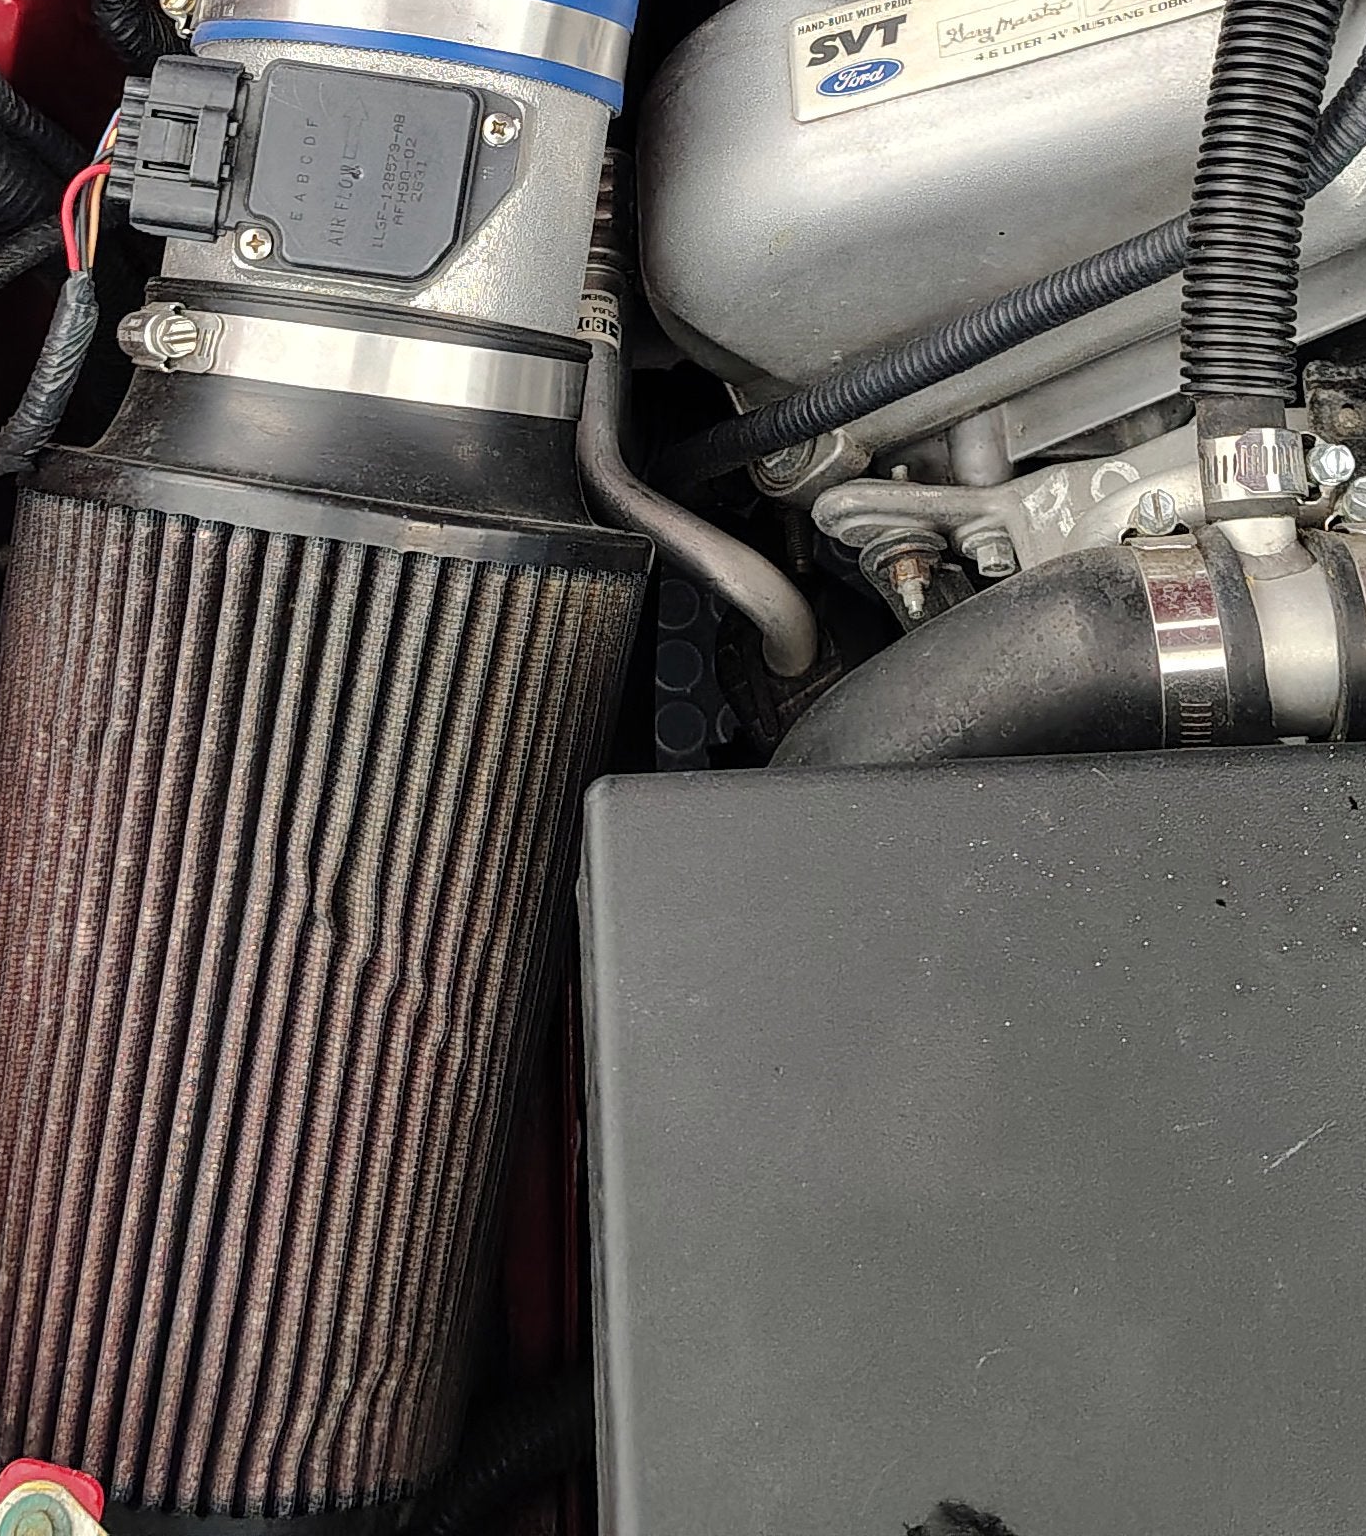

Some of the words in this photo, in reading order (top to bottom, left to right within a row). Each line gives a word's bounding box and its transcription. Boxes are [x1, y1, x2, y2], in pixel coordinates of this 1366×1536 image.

[797, 13, 853, 35] HAND-BUILT
[856, 4, 882, 18] WITH
[806, 14, 907, 68] SVT
[1003, 37, 1042, 54] LITER
[1073, 8, 1144, 34] MUSTANG
[334, 164, 355, 211] FLOW
[327, 217, 348, 247] AIR
